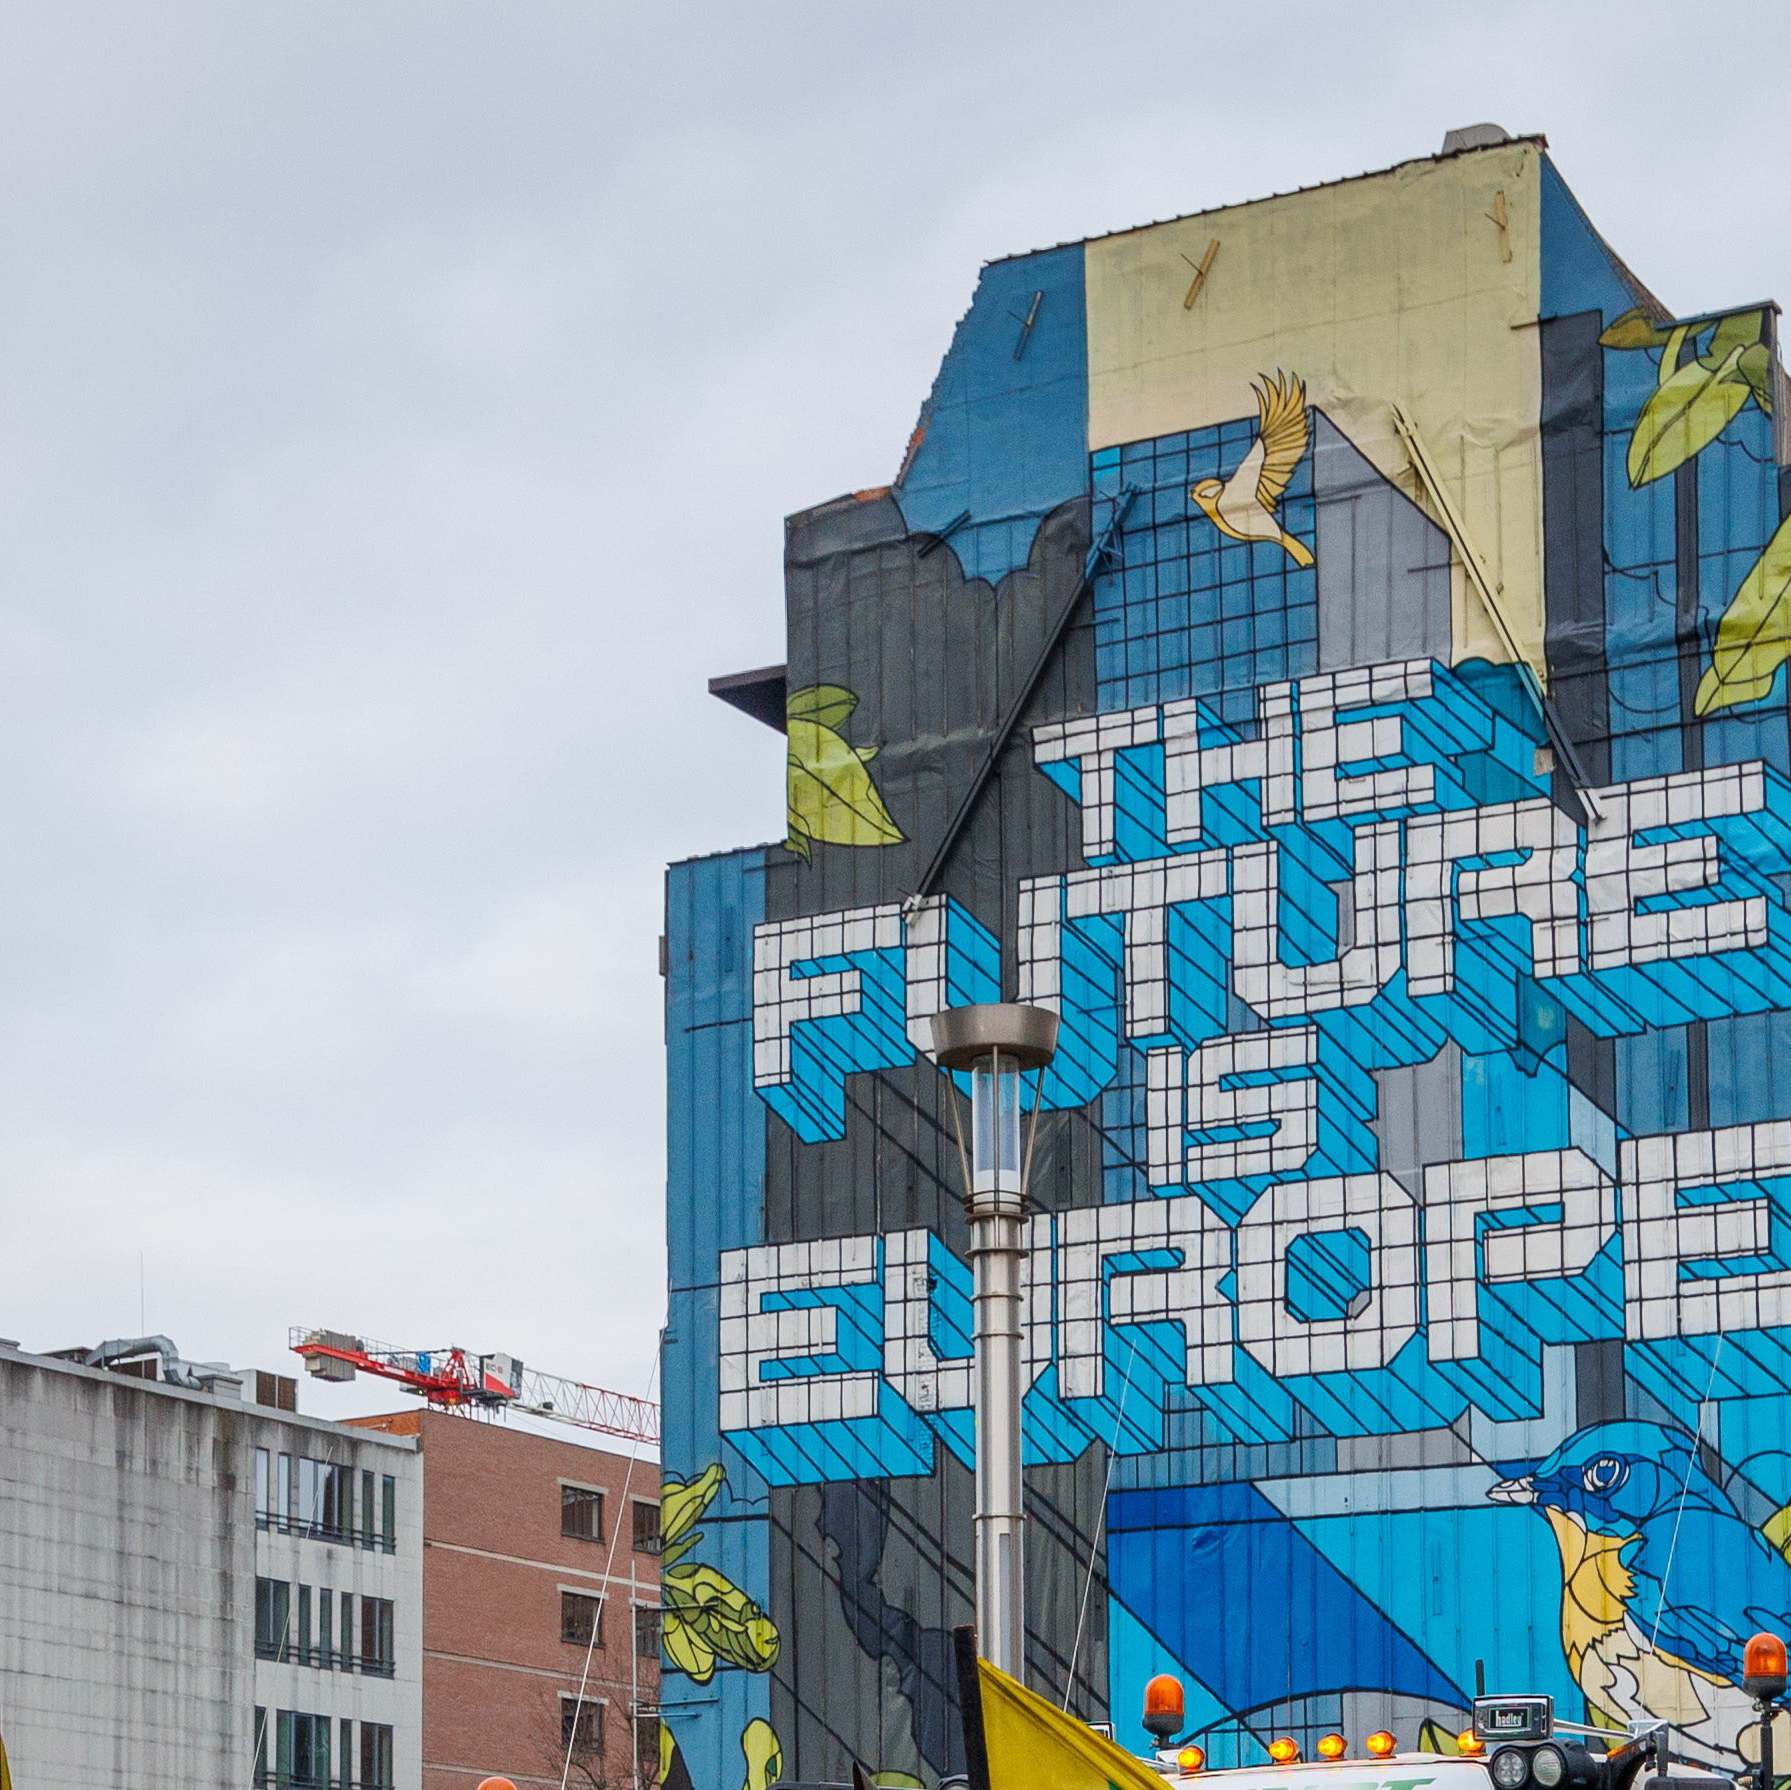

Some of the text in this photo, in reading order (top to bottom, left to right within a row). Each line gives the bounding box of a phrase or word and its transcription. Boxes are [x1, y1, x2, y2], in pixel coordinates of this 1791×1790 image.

[1034, 659, 1437, 858] THE
[753, 761, 1767, 1095] FUTURE
[1146, 1026, 1319, 1188] IS
